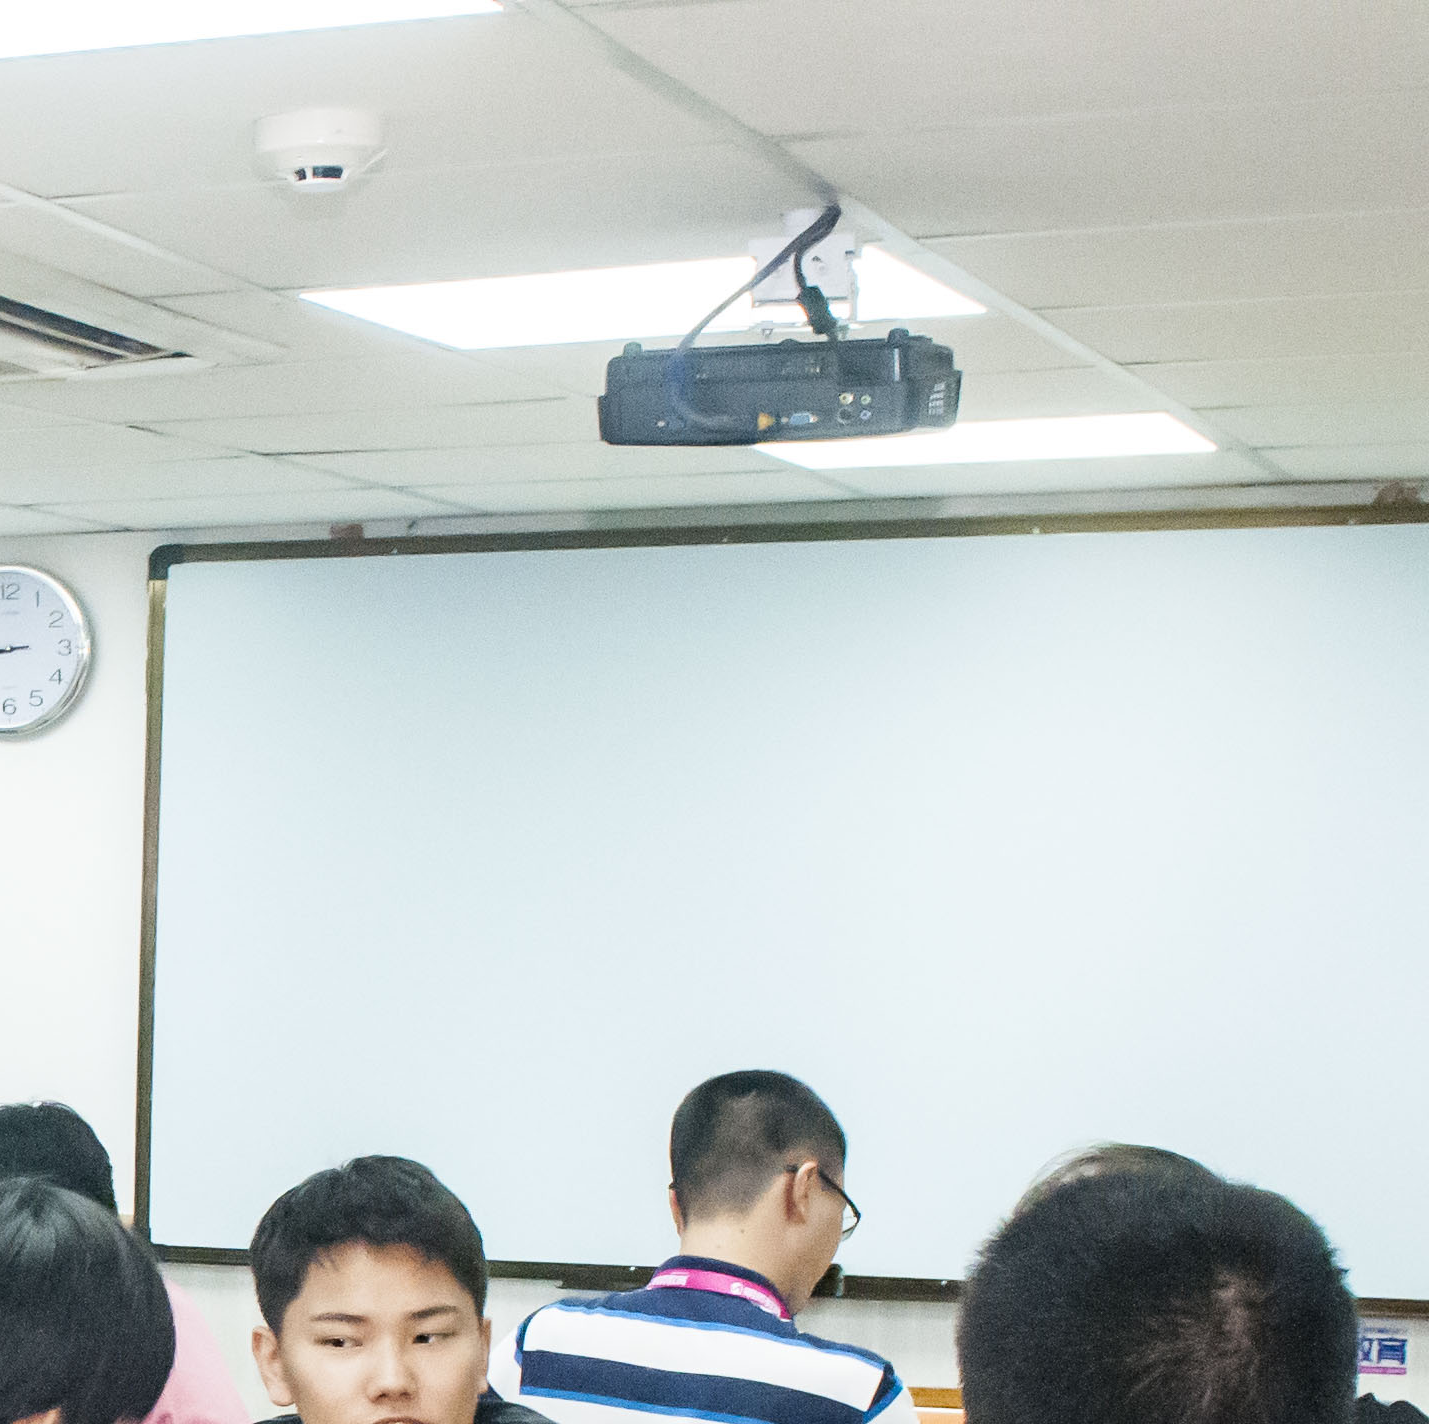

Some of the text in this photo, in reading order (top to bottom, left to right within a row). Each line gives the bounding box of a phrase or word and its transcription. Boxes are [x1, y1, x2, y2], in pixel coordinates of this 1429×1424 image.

[0, 583, 21, 601] 12
[34, 590, 41, 608] 1
[48, 610, 64, 629] 2
[57, 639, 72, 656] 3
[48, 668, 63, 685] 4
[1, 698, 17, 716] 6
[28, 689, 44, 707] 5
